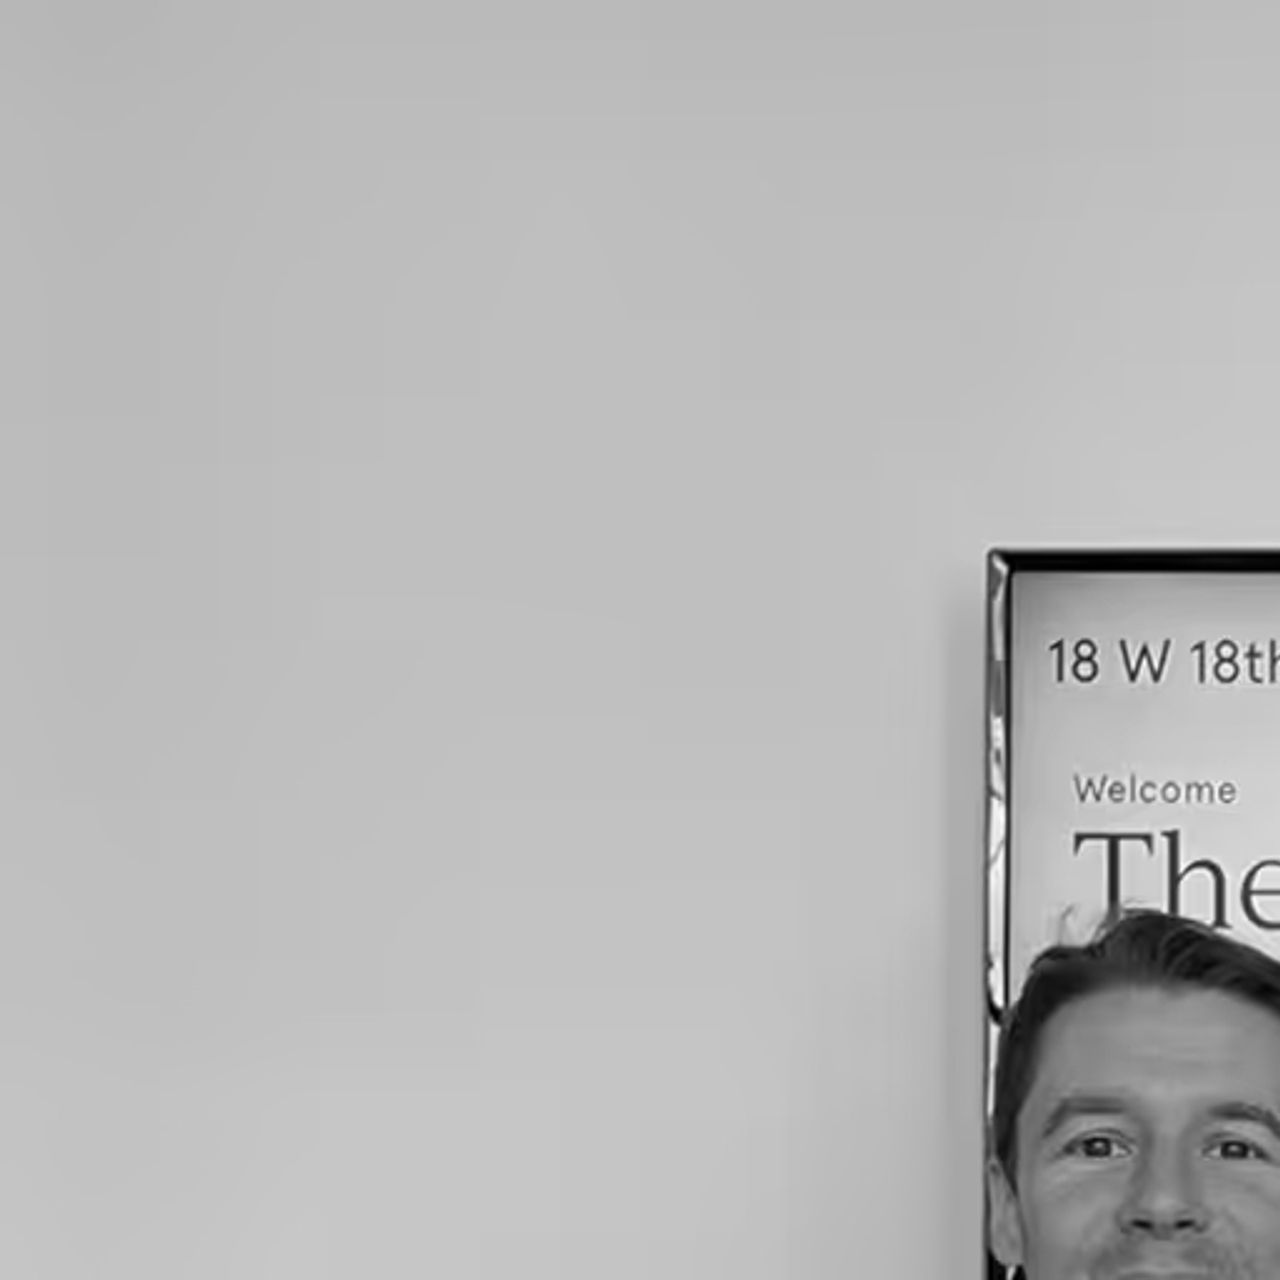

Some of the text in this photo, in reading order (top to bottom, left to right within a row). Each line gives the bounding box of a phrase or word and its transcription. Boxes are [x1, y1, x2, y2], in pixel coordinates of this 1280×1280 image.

[1049, 638, 1099, 684] 18
[1119, 638, 1171, 684] W
[1073, 773, 1238, 804] Welcome
